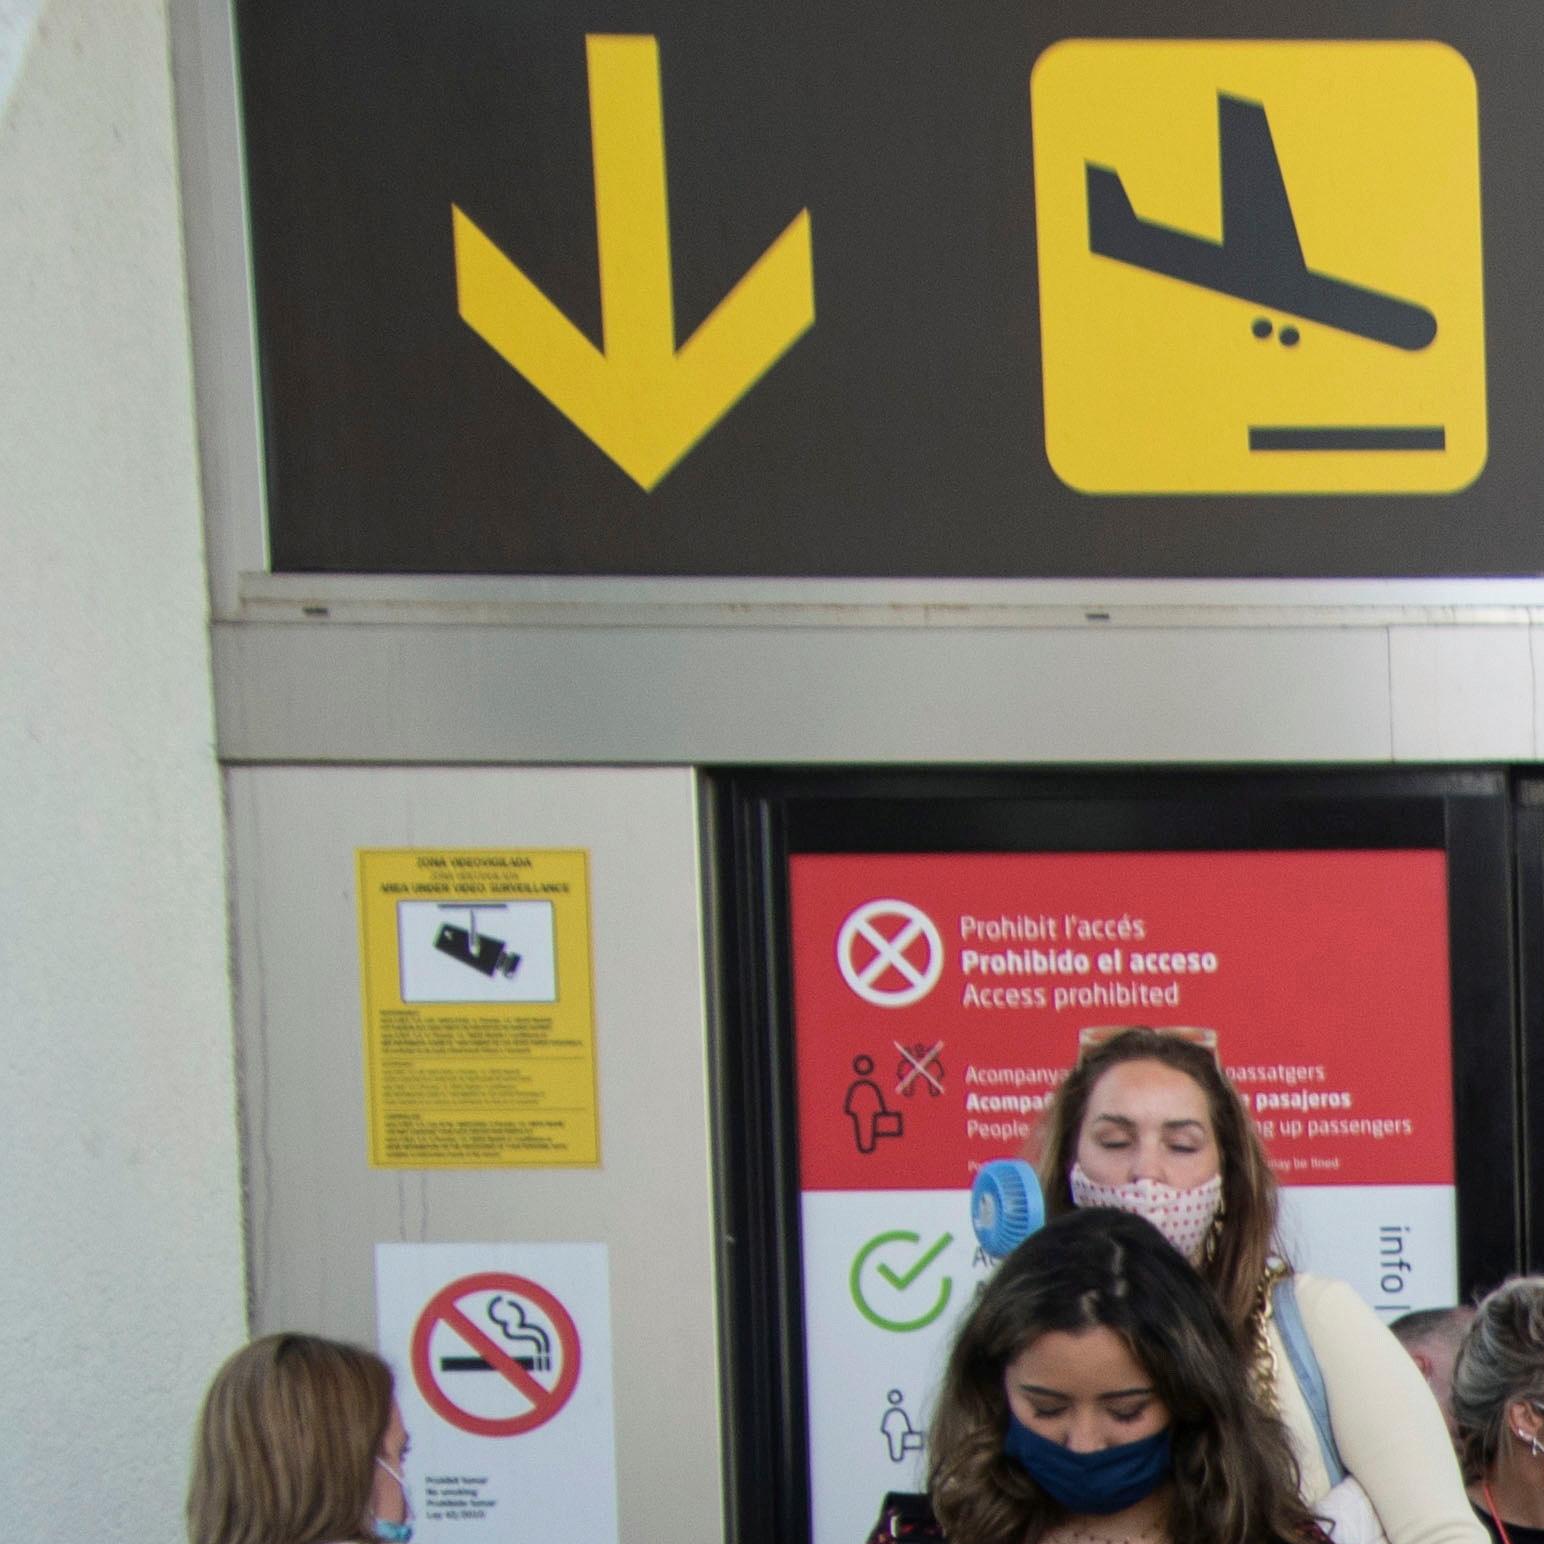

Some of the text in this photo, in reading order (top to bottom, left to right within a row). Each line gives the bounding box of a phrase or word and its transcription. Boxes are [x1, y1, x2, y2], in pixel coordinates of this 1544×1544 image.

[960, 913, 1147, 941] Prohibit l'accés
[961, 948, 1218, 975] Prohibido el acceso
[963, 982, 1180, 1012] Access prohibited
[1256, 1089, 1351, 1112] pasajeros
[967, 1119, 1030, 1141] People
[1280, 1120, 1302, 1137] up
[1308, 1118, 1412, 1138] passengers
[1380, 1227, 1411, 1293] info
